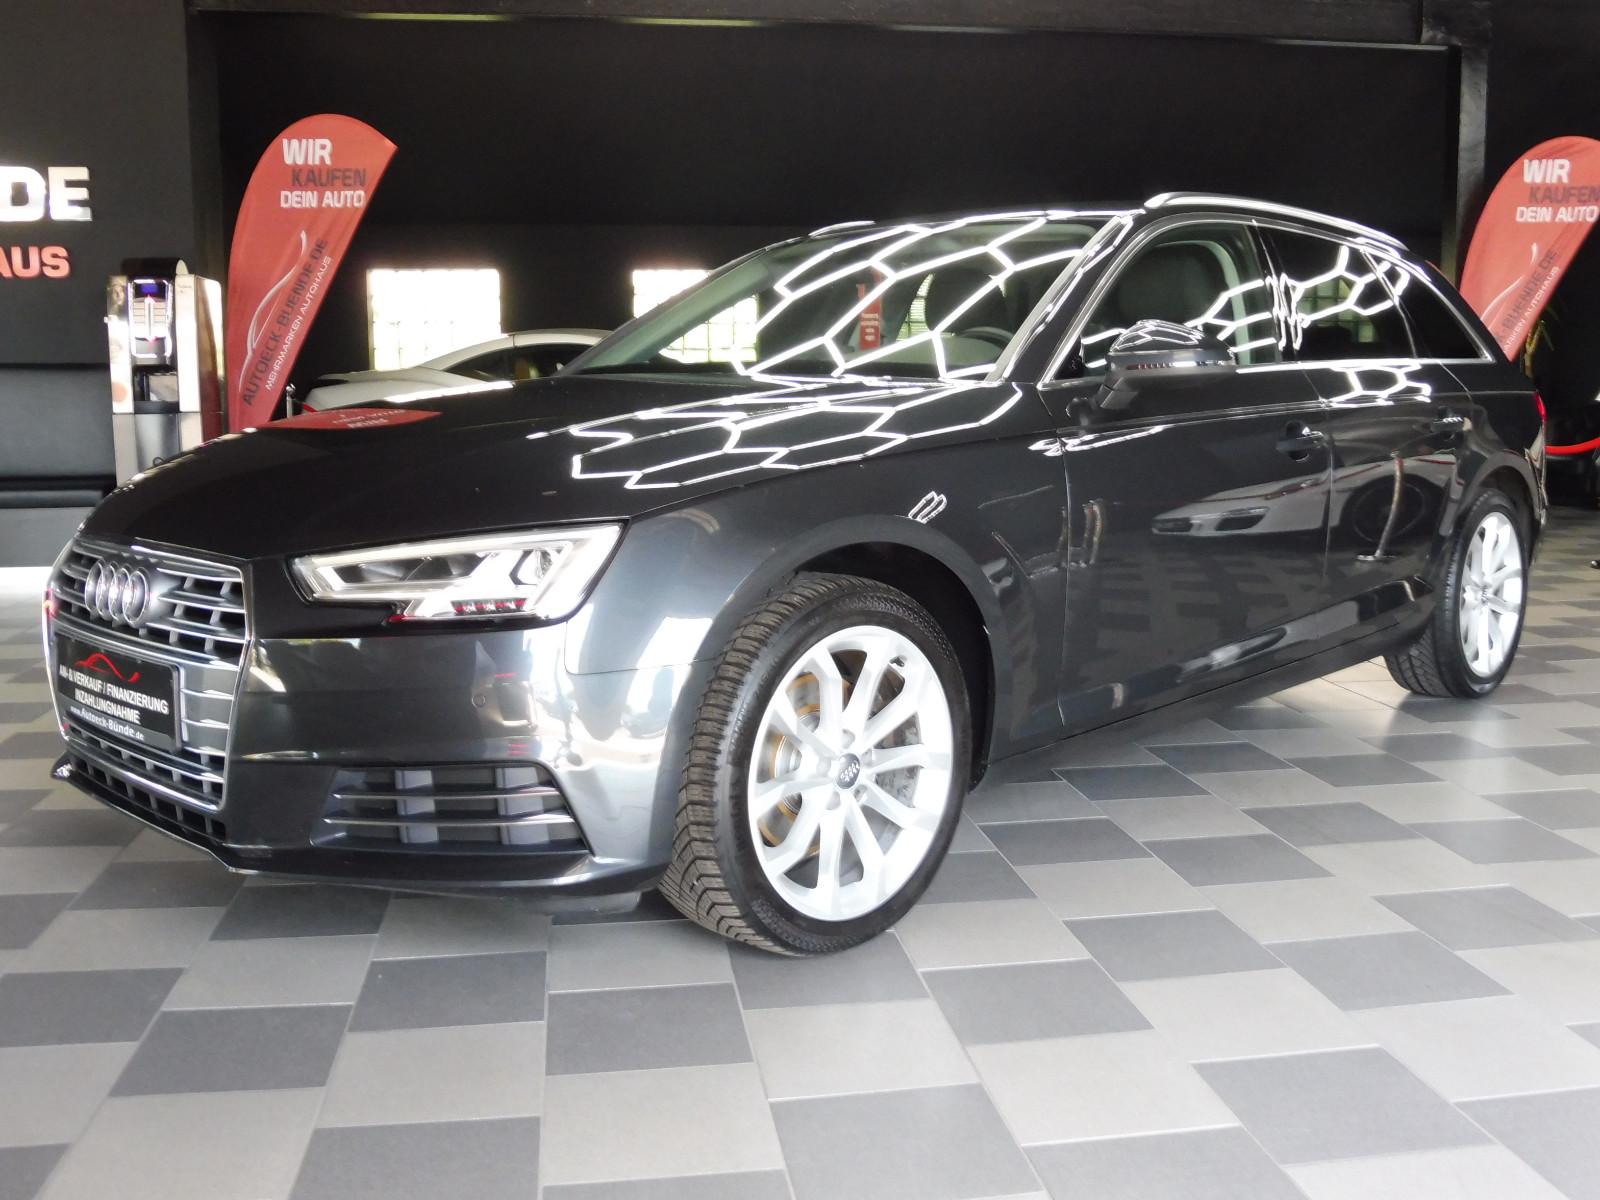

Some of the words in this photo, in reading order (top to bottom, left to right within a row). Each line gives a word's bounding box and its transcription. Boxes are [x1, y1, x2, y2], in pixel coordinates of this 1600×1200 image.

[282, 138, 333, 166] WIR
[291, 168, 367, 187] KAUFEN
[1523, 159, 1570, 184] WIR
[280, 190, 318, 208] DEIN
[322, 190, 366, 208] AUTO
[1516, 206, 1552, 222] DEIN
[1554, 205, 1599, 222] AUTO
[1525, 266, 1560, 320] AUTOHAUS
[265, 315, 304, 392] MEHRMARKEN
[299, 255, 332, 315] AUTOHAUS
[72, 670, 104, 693] VERKAUF
[106, 683, 170, 715] FINANZIERUNG
[74, 688, 142, 726] INZAHLUNGNAHME
